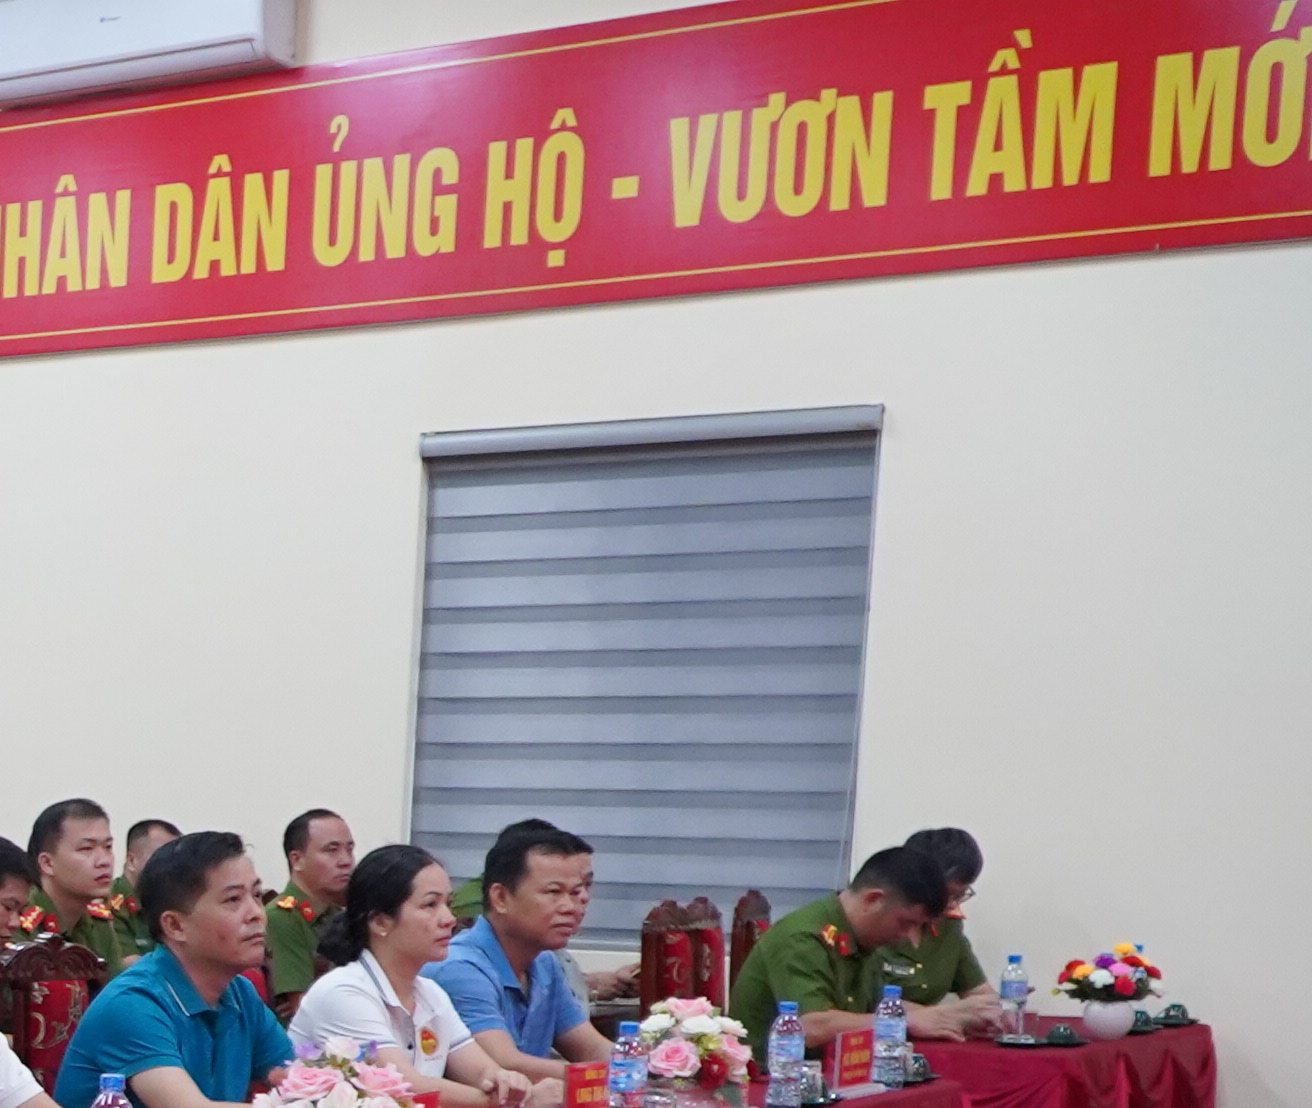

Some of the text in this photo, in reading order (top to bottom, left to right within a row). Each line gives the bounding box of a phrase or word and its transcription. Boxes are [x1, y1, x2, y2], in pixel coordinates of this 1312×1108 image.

[150, 153, 290, 284] DÂN
[311, 115, 460, 267] ỦNG
[482, 107, 586, 268] HỘ
[669, 88, 894, 229] VƯƠN
[922, 28, 1119, 202] TẦM
[1147, 0, 1312, 178] MỚ
